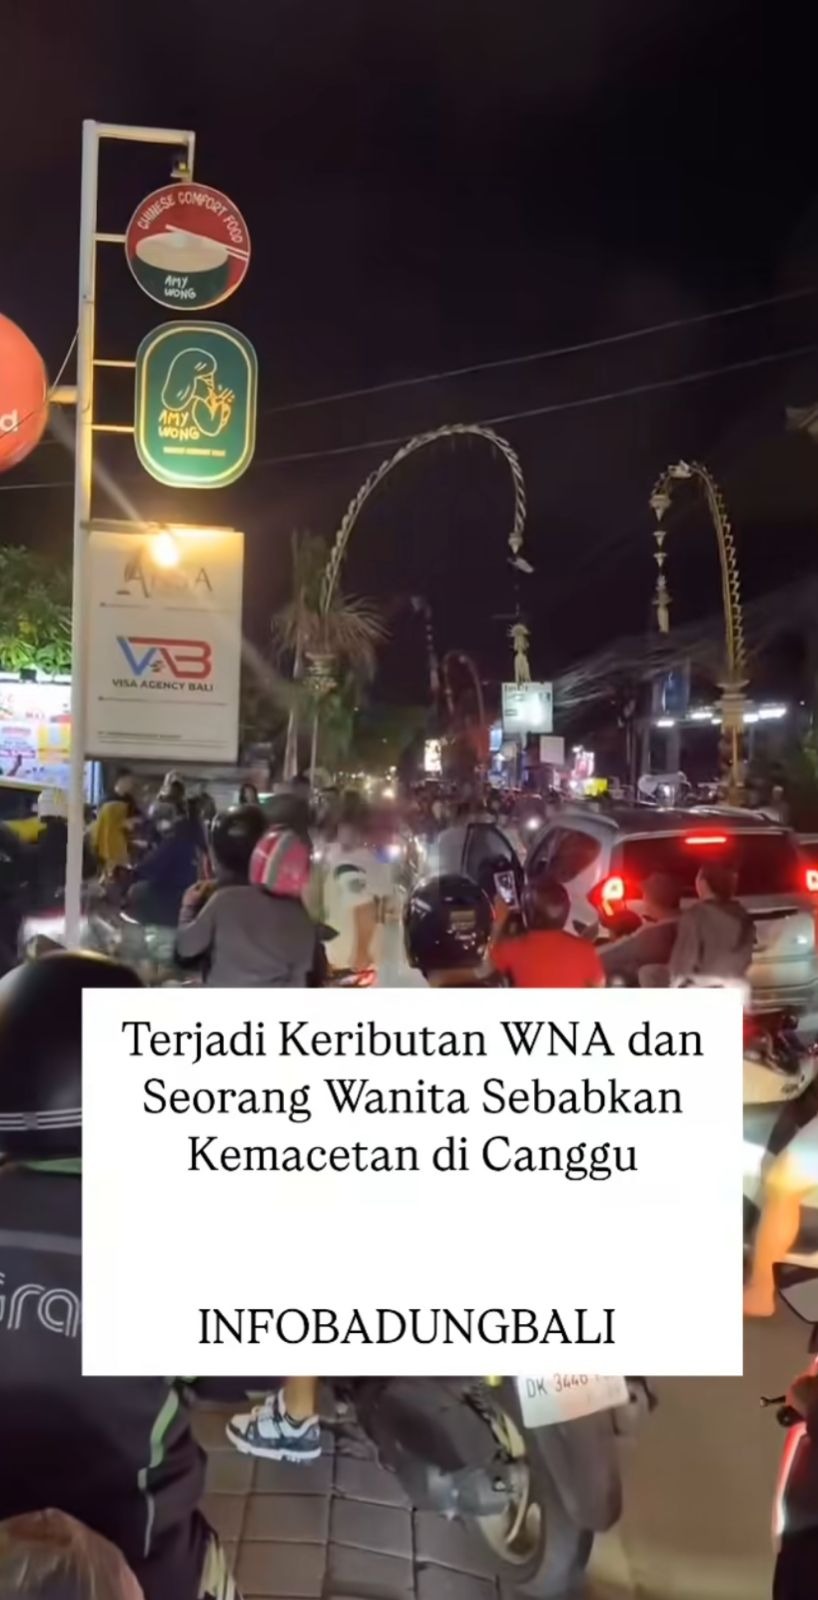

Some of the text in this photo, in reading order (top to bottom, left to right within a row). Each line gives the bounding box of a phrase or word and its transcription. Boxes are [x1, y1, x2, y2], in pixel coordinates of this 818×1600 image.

[137, 191, 243, 243] CHINESE COMFORT FOOD
[164, 275, 188, 289] AMY
[164, 288, 197, 300] WONG
[158, 409, 189, 428] AMY
[158, 426, 200, 441] WONG
[112, 679, 214, 692] VISA AGENCY BALI
[526, 1377, 548, 1398] DK
